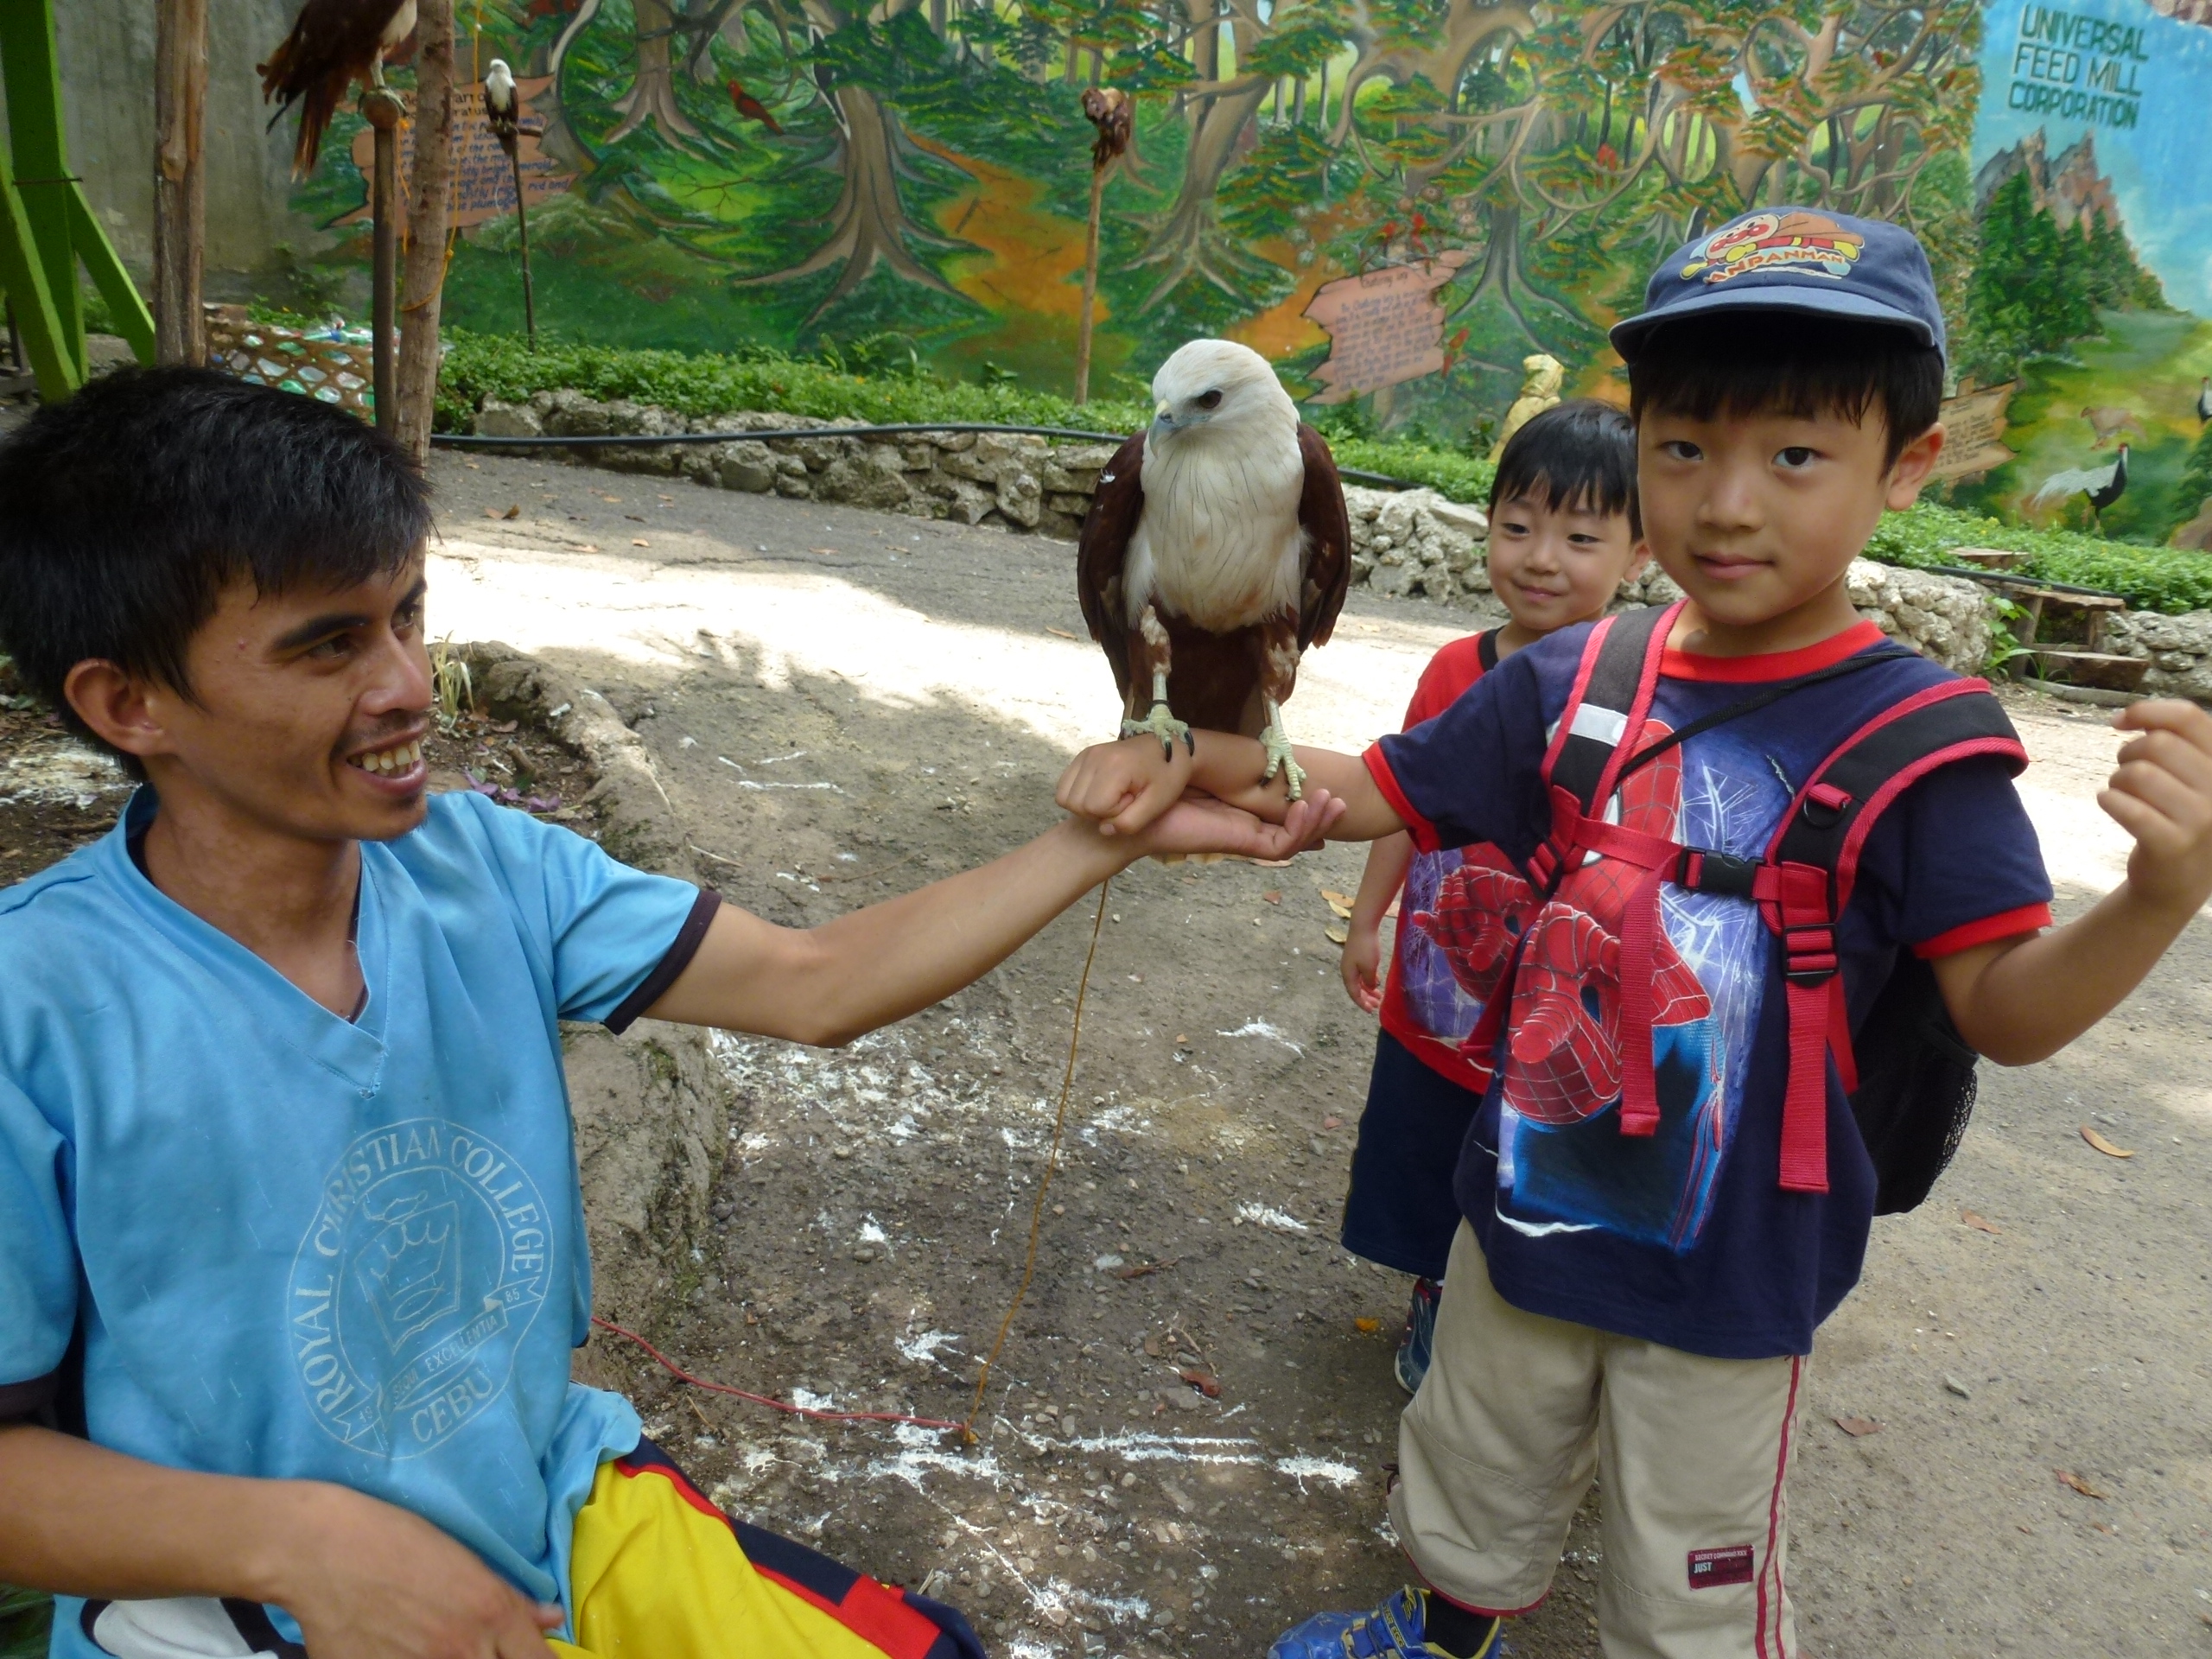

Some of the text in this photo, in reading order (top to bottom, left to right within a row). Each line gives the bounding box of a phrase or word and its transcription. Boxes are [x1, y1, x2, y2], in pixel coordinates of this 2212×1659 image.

[2022, 4, 2149, 61] UNIVERSAL
[2013, 42, 2142, 97] FEED MILL
[2008, 81, 2139, 129] CORPORATION
[1707, 250, 1845, 284] ANPANMAN
[293, 1274, 354, 1414] ROYAL
[451, 1135, 545, 1273] COLLEGE
[424, 1315, 499, 1373] EXCELLENTIA
[412, 1365, 493, 1442] CEBU
[1694, 1561, 1712, 1573] JUST
